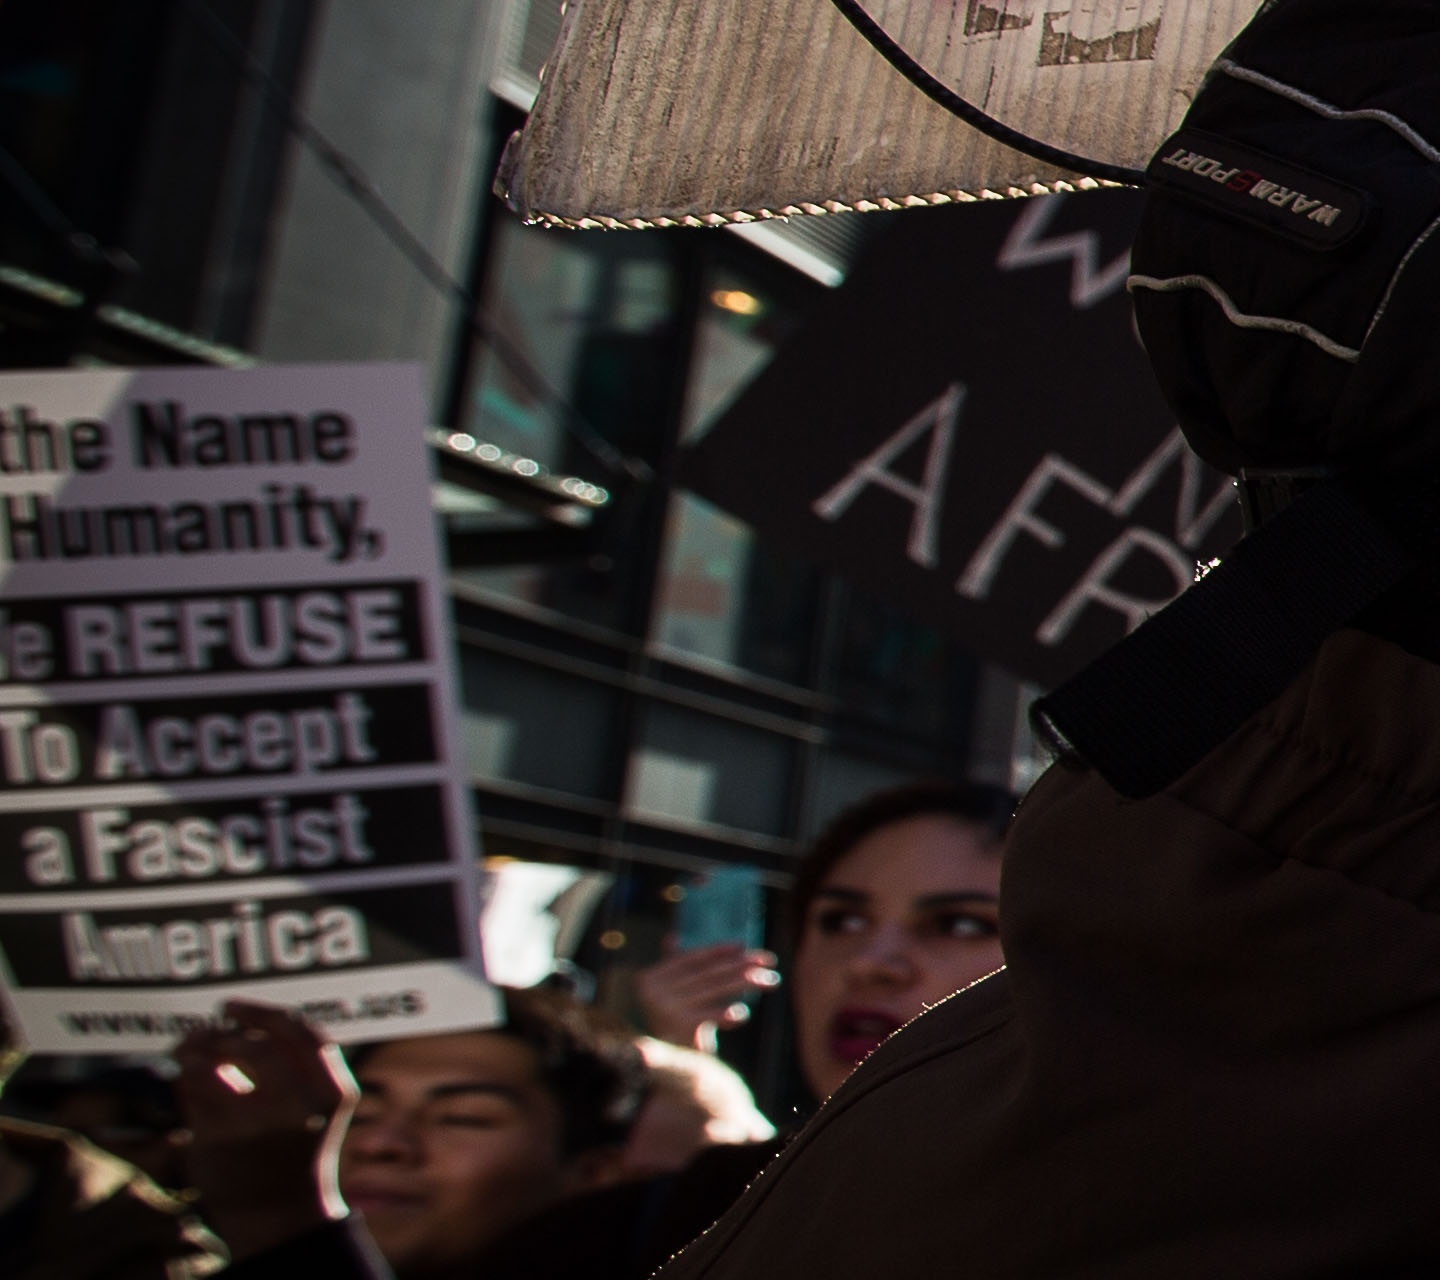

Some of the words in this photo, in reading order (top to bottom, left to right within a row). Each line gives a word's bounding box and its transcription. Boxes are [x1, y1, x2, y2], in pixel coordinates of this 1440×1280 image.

[131, 399, 356, 470] Name
[2, 486, 385, 564] Humanity,
[64, 588, 407, 677] REFUSE
[93, 691, 379, 781] Accept
[22, 824, 76, 886] a
[78, 794, 376, 883] Fascist
[61, 902, 373, 982] America
